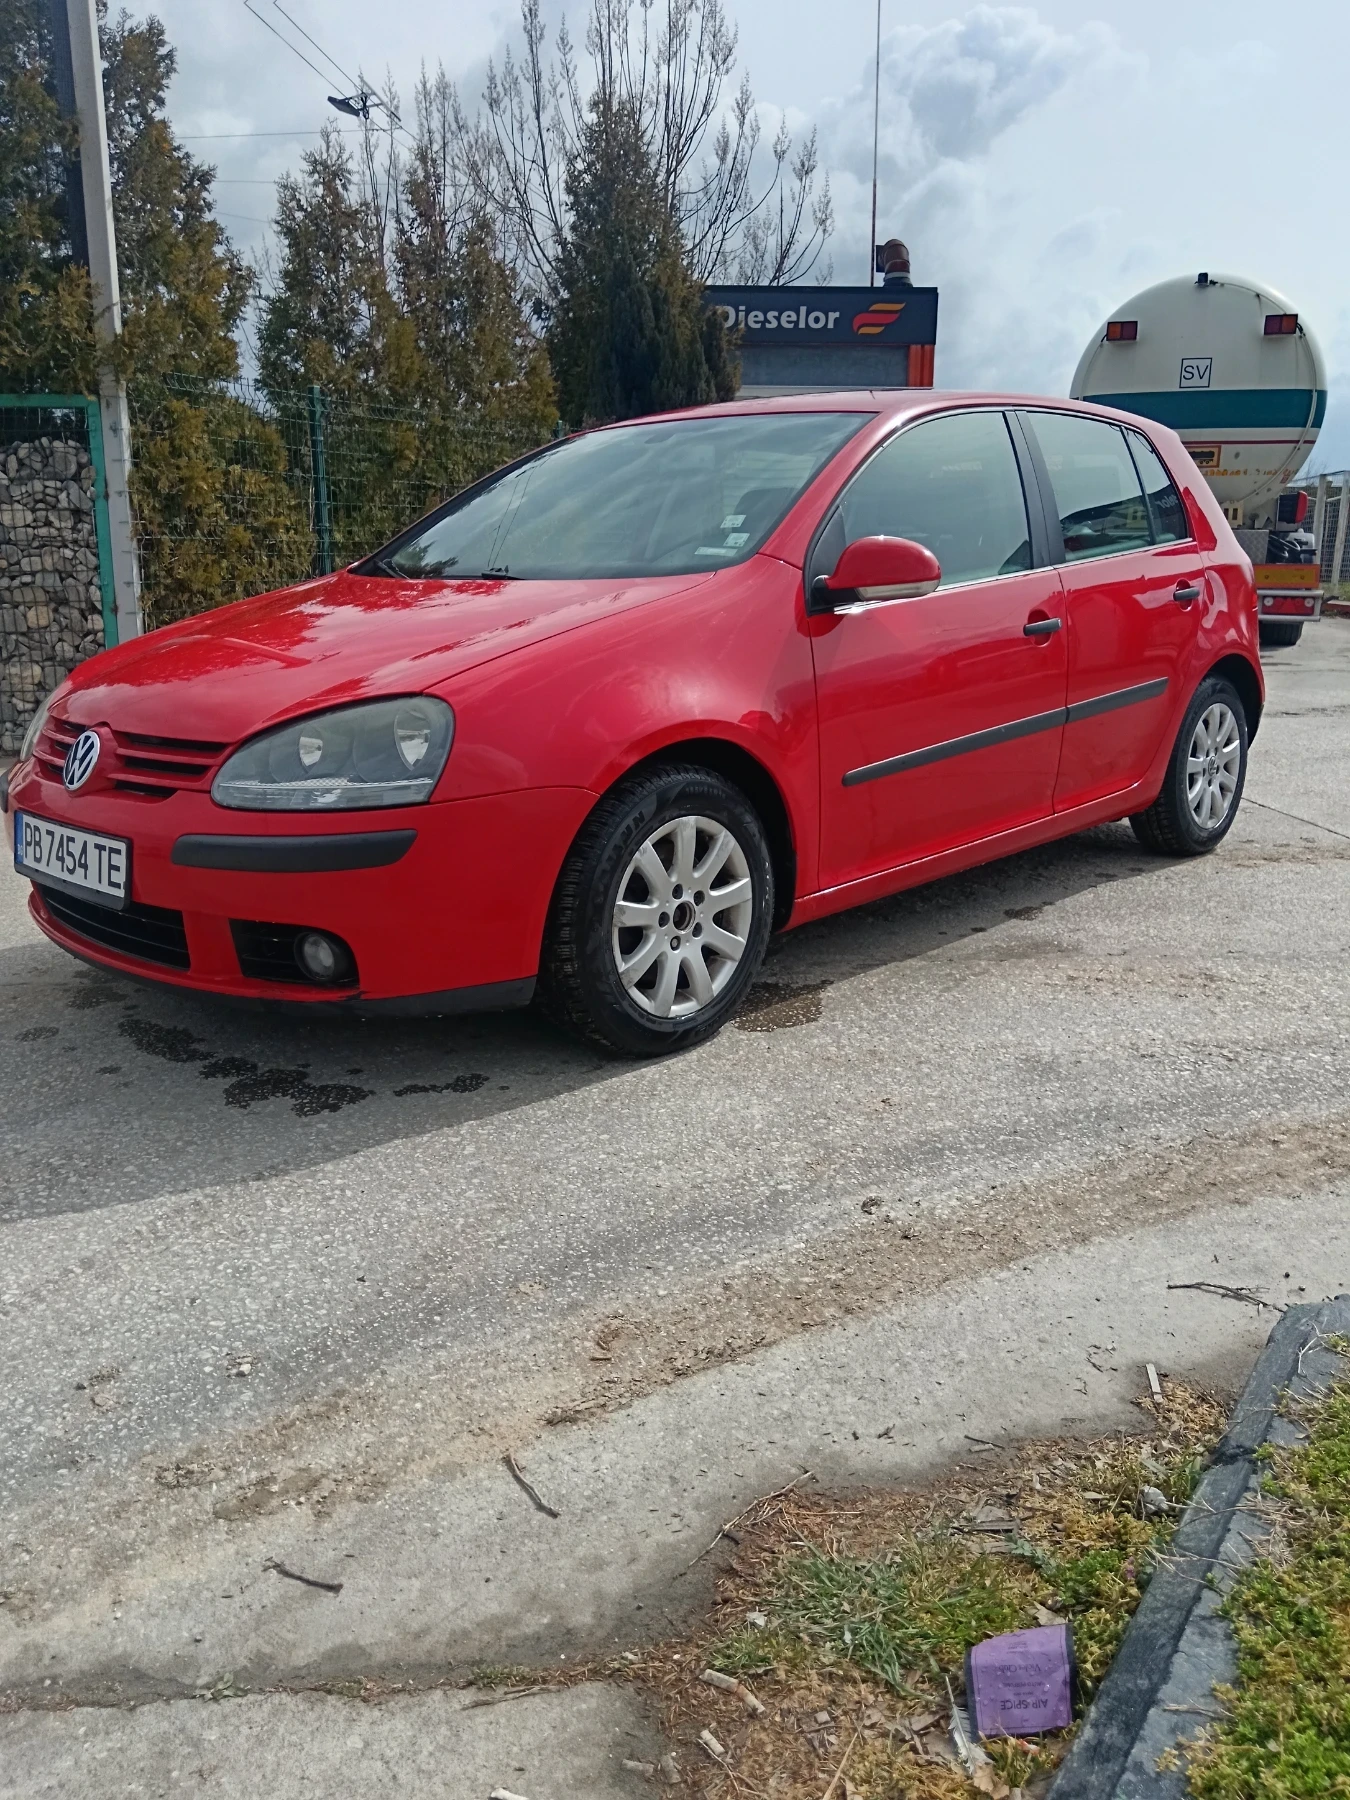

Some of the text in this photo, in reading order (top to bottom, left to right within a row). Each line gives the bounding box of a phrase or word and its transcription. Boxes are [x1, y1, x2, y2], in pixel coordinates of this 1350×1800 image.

[1182, 364, 1209, 381] SV
[24, 821, 122, 890] PB 7454 TE
